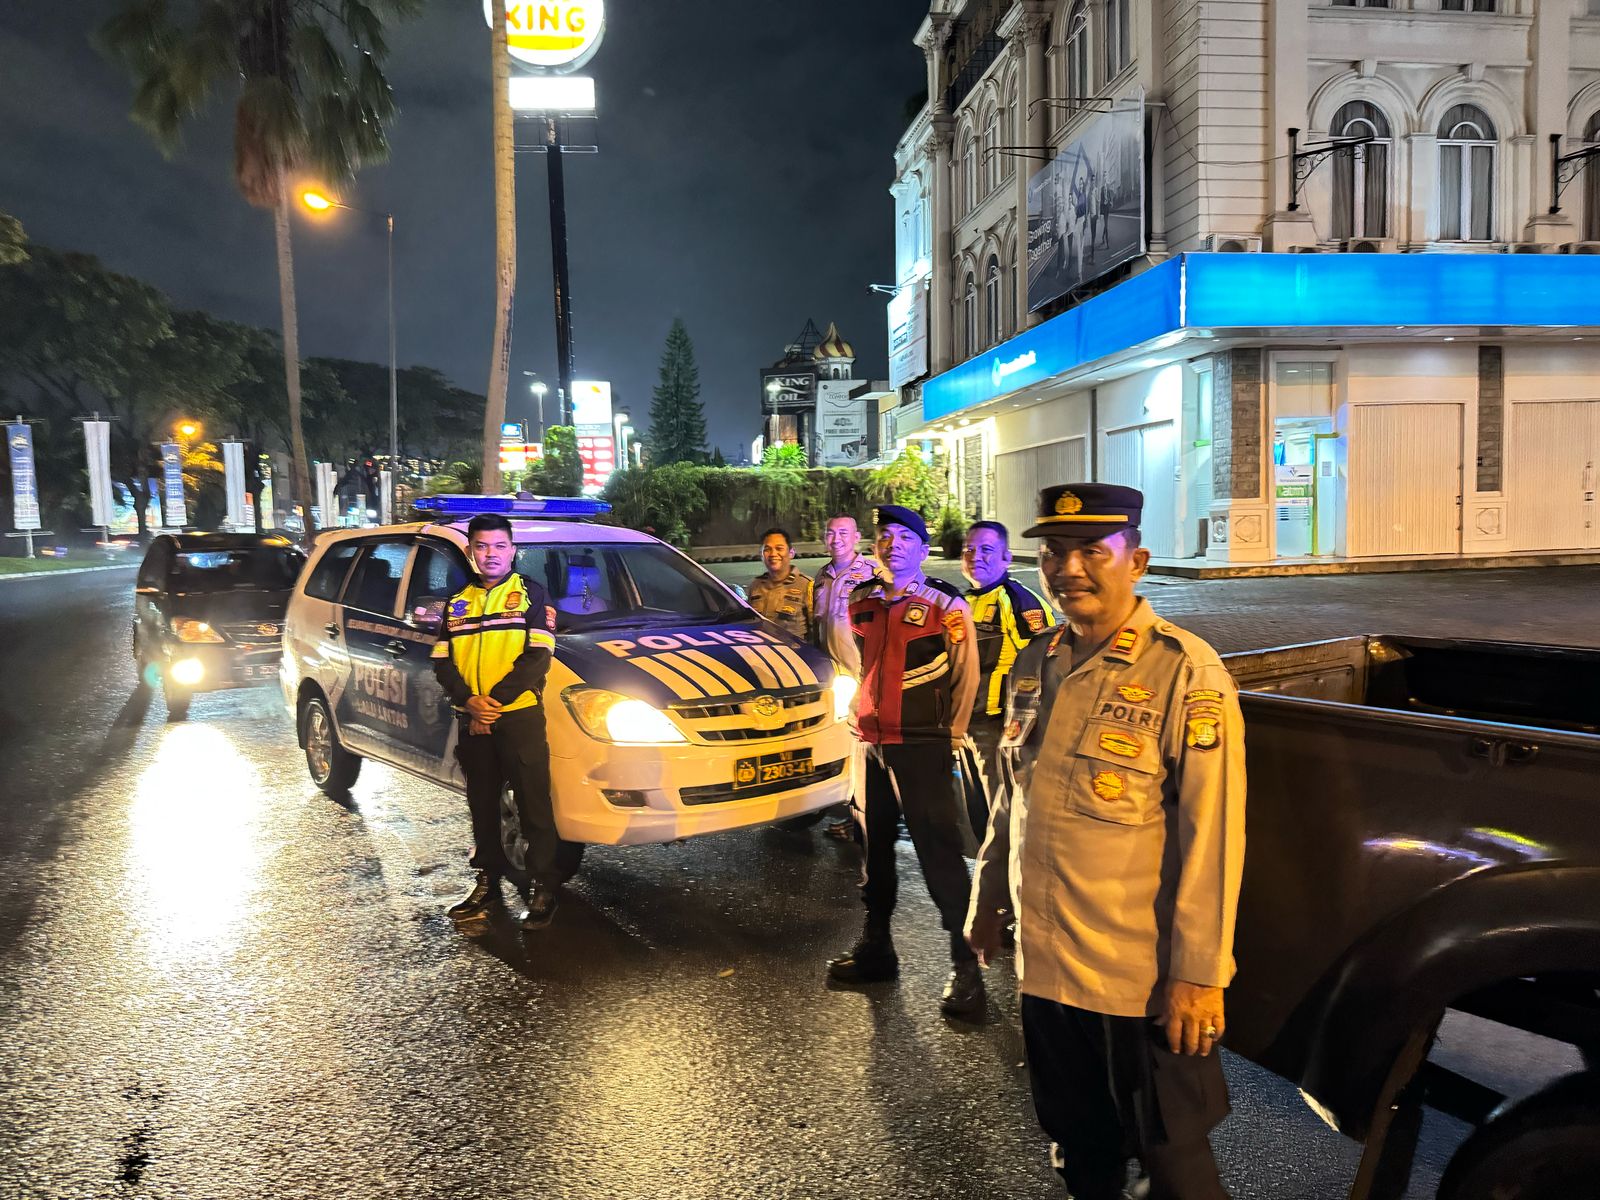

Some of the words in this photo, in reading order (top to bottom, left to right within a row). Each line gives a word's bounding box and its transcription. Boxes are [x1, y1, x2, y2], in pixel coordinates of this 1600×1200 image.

[505, 5, 586, 32] KING
[774, 376, 810, 387] KING
[596, 629, 784, 658] POLISI
[354, 661, 408, 706] POLISI
[1100, 702, 1161, 729] POLRI
